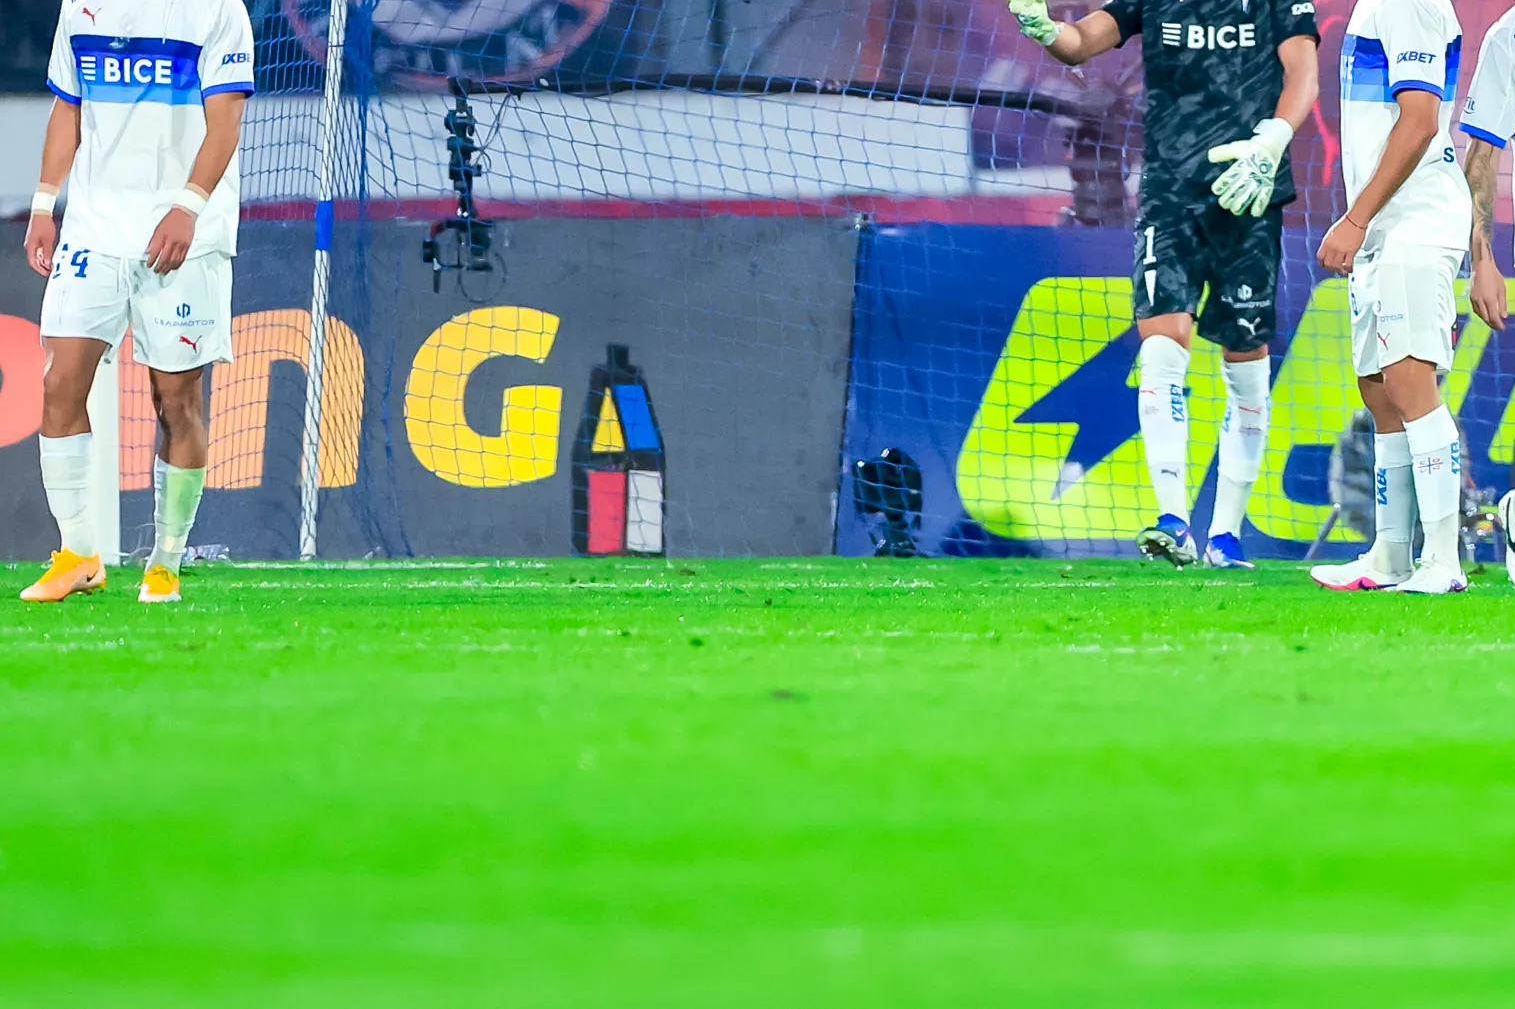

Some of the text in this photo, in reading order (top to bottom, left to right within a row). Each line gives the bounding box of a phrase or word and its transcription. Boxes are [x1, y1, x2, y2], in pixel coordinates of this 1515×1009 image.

[1186, 23, 1256, 51] BICE
[104, 56, 173, 84] BICE
[1396, 50, 1437, 65] 1XBET
[1143, 225, 1157, 265] 1
